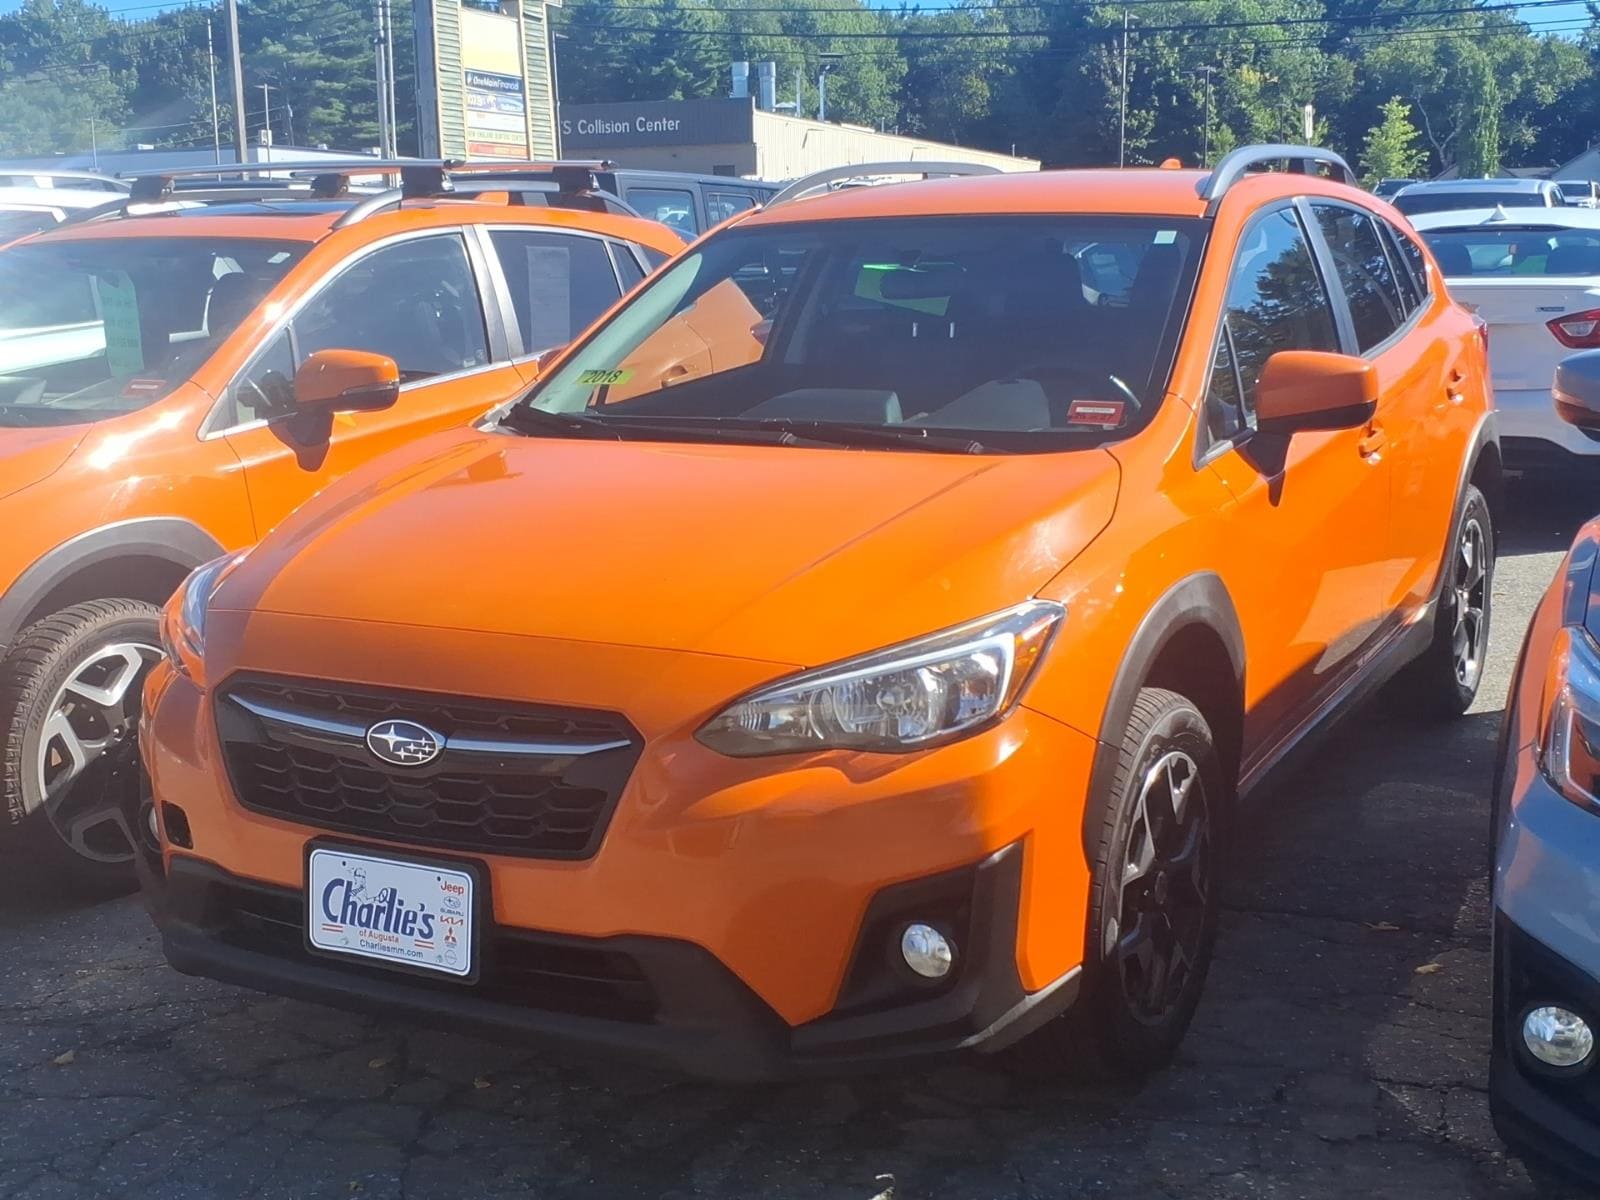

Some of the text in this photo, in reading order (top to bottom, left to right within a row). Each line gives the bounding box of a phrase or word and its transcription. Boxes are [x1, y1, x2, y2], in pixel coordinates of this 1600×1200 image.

[577, 119, 630, 134] Collision
[635, 116, 681, 132] Center
[440, 881, 465, 895] Jeep
[322, 878, 435, 940] Charlie's
[359, 929, 400, 943] of Augusta
[359, 939, 424, 958] Charliesmm.com
